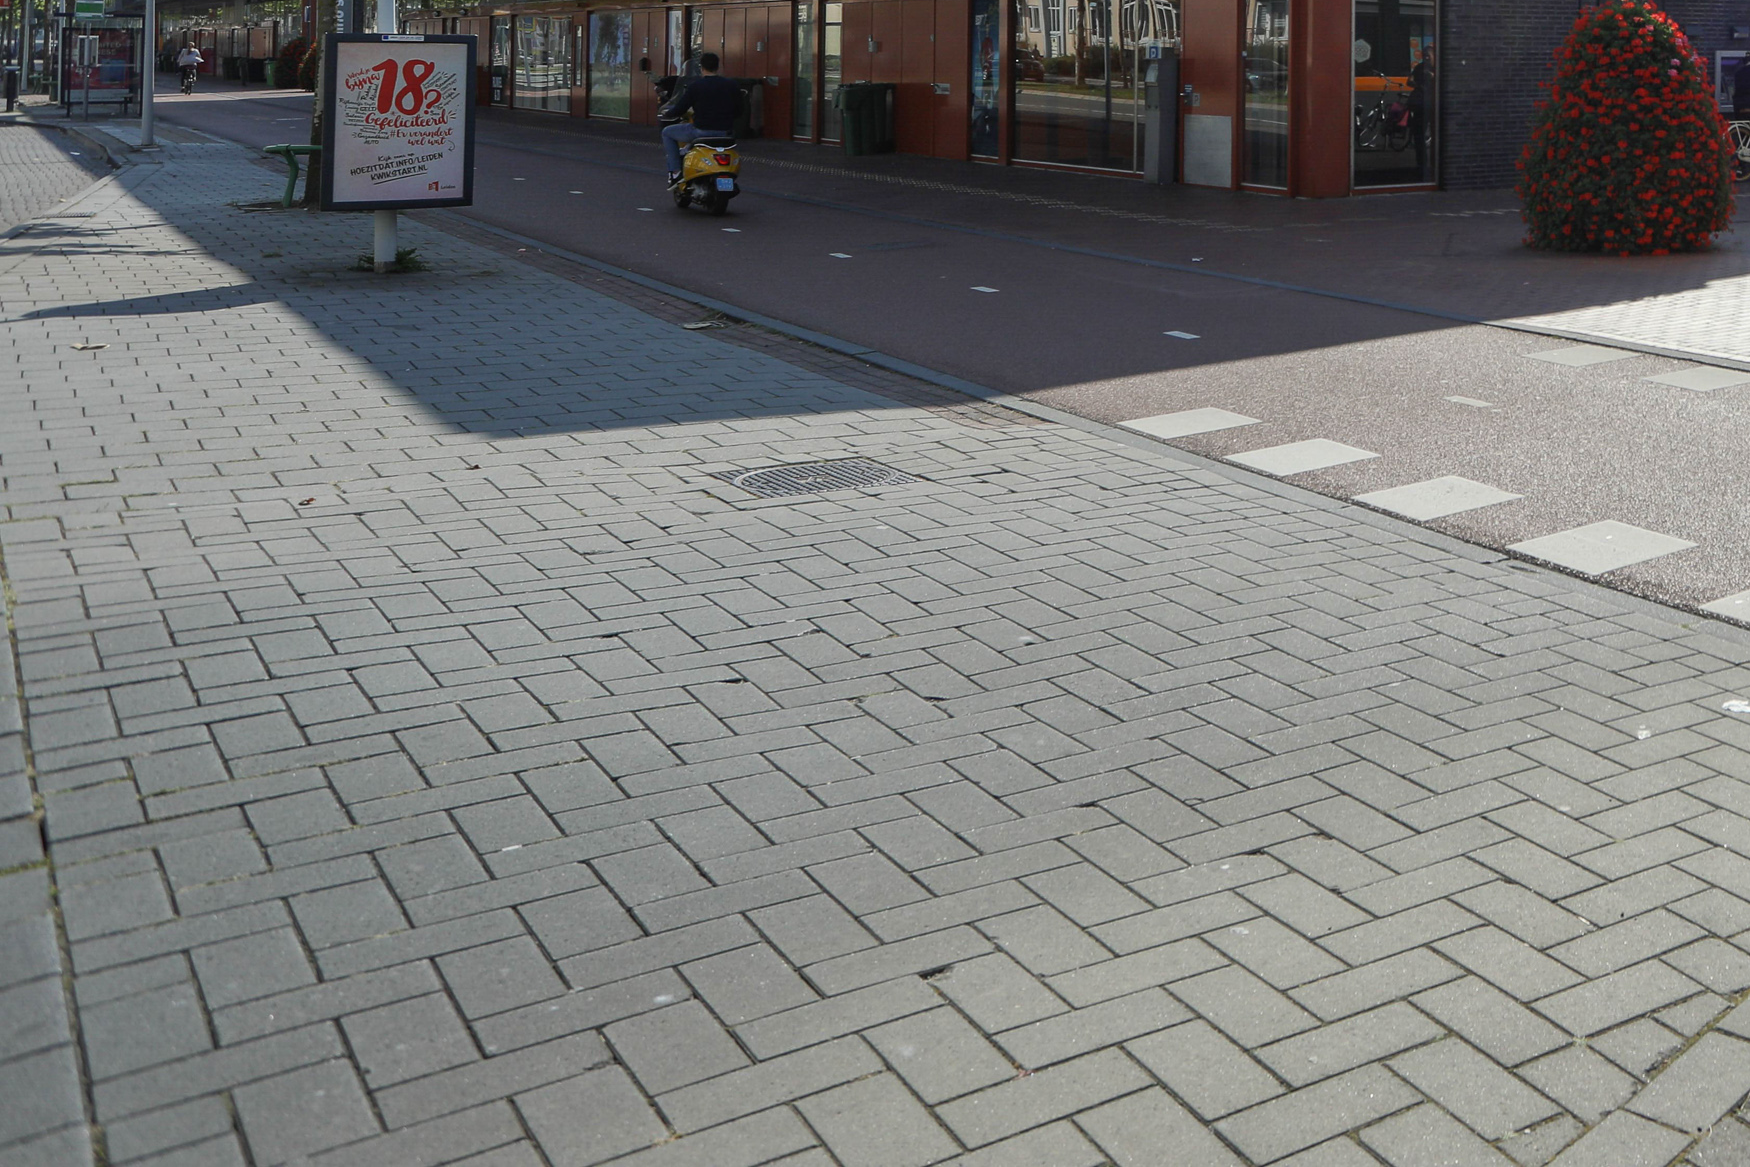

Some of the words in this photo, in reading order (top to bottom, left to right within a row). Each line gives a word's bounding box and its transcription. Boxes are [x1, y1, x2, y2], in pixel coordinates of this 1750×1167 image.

[345, 71, 381, 92] bijna
[364, 108, 449, 131] Gefeliciteerd
[407, 137, 425, 146] wel
[428, 136, 446, 145] wat
[409, 126, 453, 139] verandert
[350, 152, 443, 176] HOEZITDAT.INFO/LEIDEN
[370, 164, 428, 181] KWIKSTART.NL
